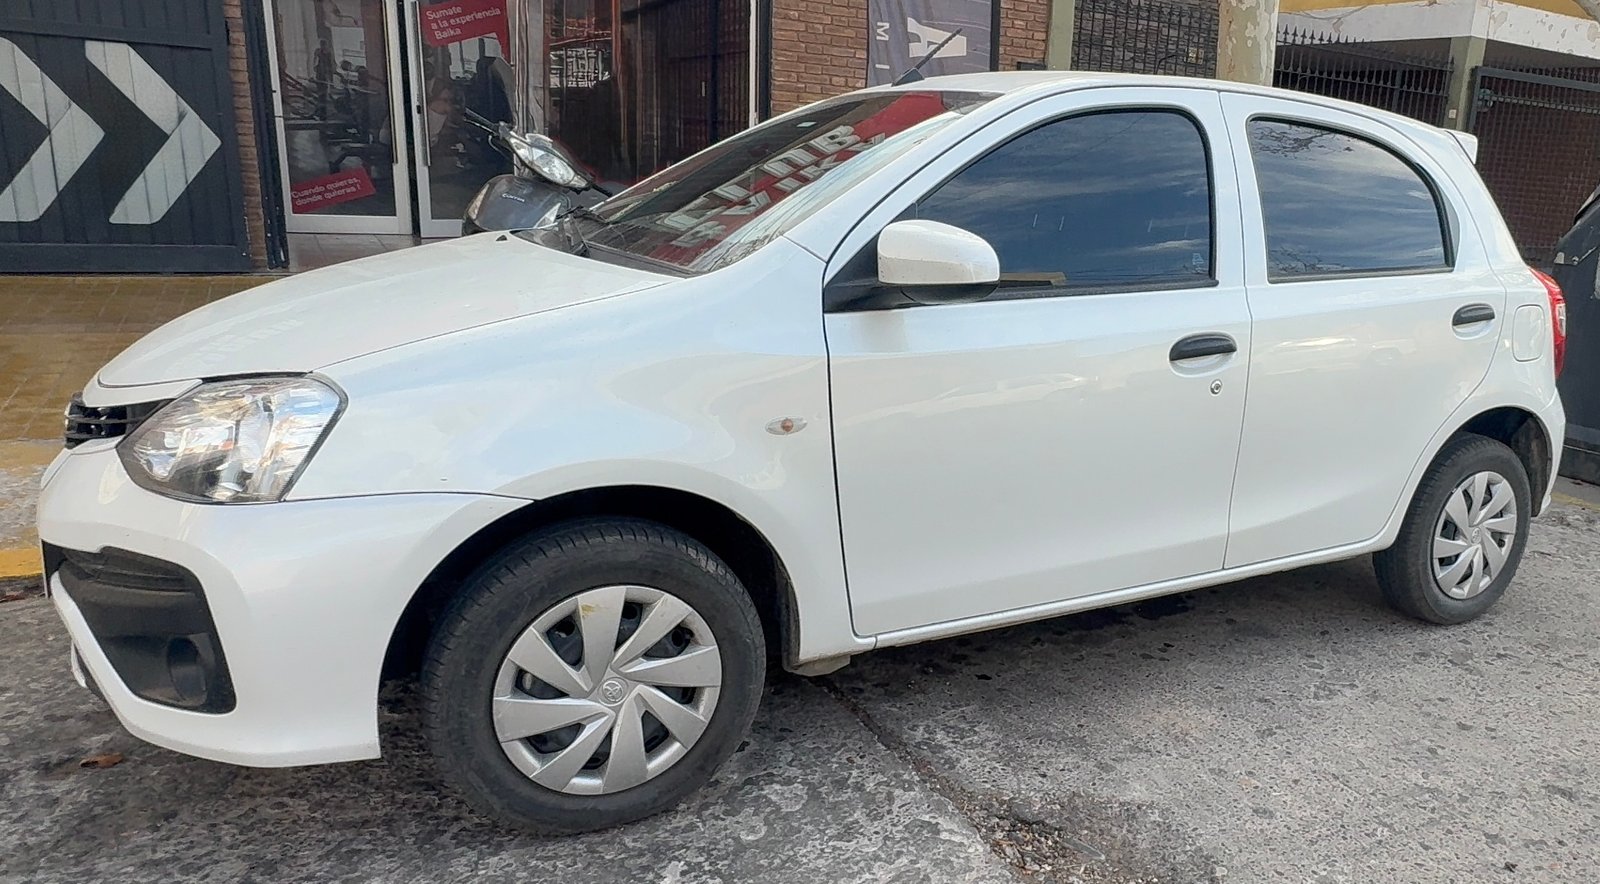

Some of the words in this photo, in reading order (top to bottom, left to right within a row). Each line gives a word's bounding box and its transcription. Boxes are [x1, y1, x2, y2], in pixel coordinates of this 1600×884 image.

[426, 6, 462, 20] Sumate
[431, 22, 437, 30] a
[439, 20, 449, 28] la
[450, 8, 501, 25] experiencia
[434, 28, 461, 39] Baika
[292, 185, 325, 199] Cuando
[296, 194, 323, 206] donde
